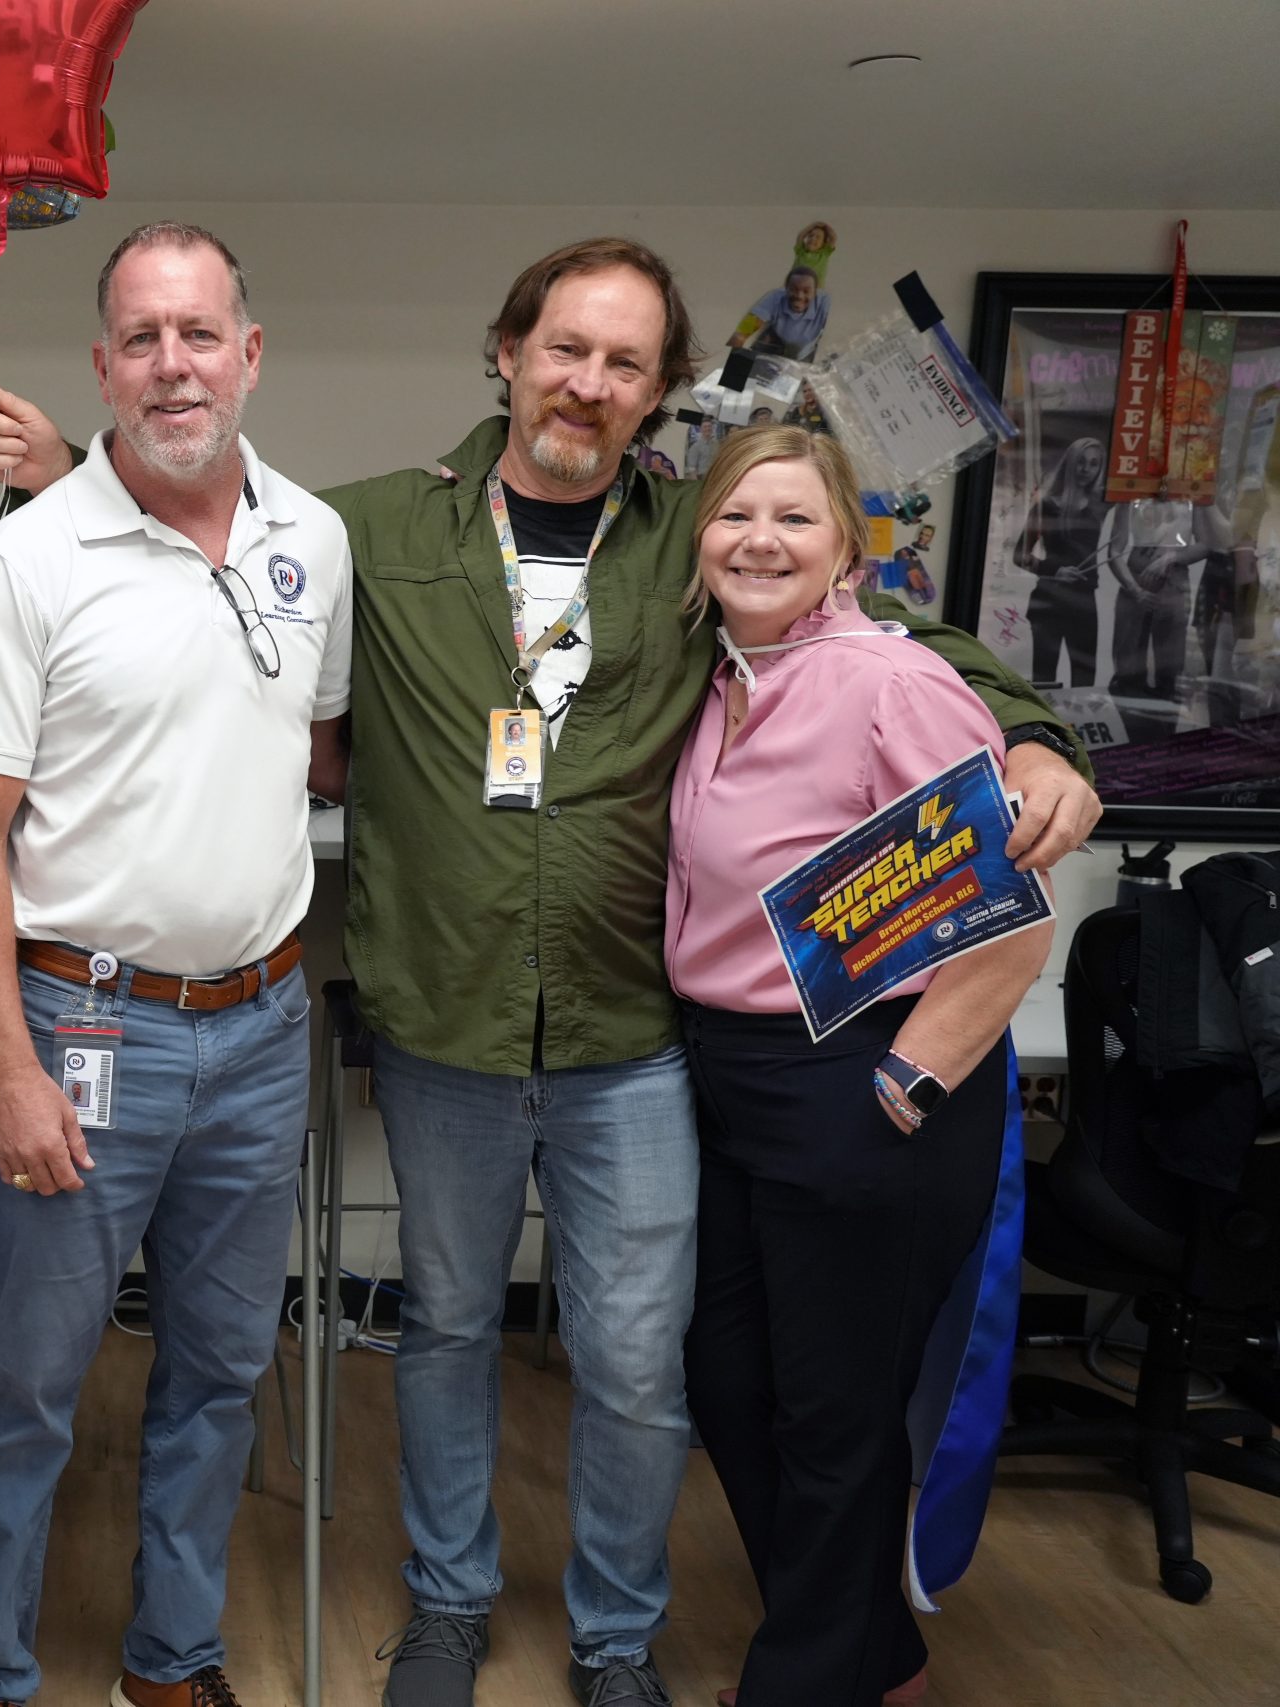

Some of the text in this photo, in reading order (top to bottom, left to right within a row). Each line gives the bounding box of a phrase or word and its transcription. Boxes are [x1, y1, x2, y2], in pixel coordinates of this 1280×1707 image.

[924, 363, 968, 420] EVIDENCE
[1116, 314, 1156, 475] BELIEVE
[260, 612, 286, 622] Learning
[799, 837, 918, 932] SUPER
[817, 825, 976, 943] TEACHER
[818, 840, 895, 904] RICHARDSON ISD
[851, 882, 975, 974] Richardson High School, RLC
[877, 893, 937, 940] Brent Morton
[965, 907, 989, 924] TABITHA
[988, 897, 1016, 913] BRANUM
[986, 920, 1009, 933] THINKER
[1012, 909, 1039, 922] TEAMMATE
